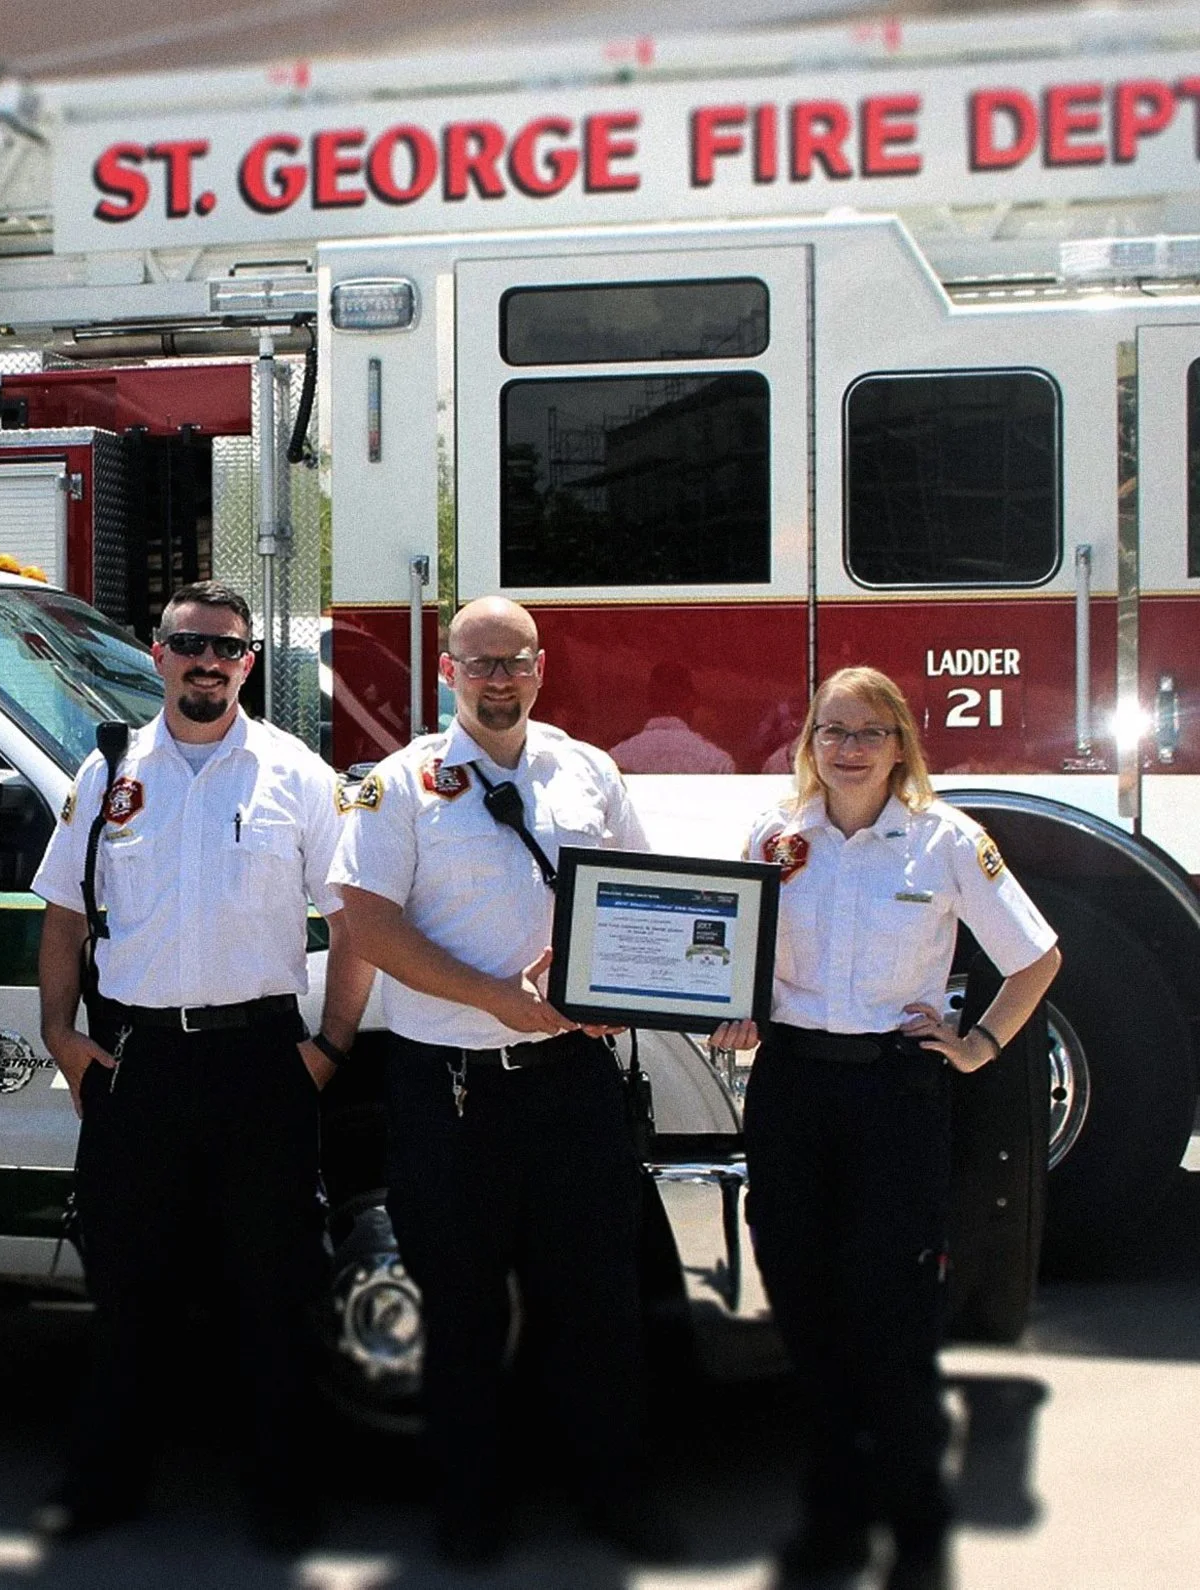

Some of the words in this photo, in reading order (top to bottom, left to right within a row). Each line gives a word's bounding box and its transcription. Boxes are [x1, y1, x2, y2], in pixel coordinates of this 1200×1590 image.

[93, 138, 217, 223] ST.
[237, 110, 641, 215] GEORGE
[690, 93, 923, 188] FIRE
[926, 648, 1021, 676] LADDER
[945, 687, 1003, 728] 21
[0, 1057, 55, 1069] STROKE
